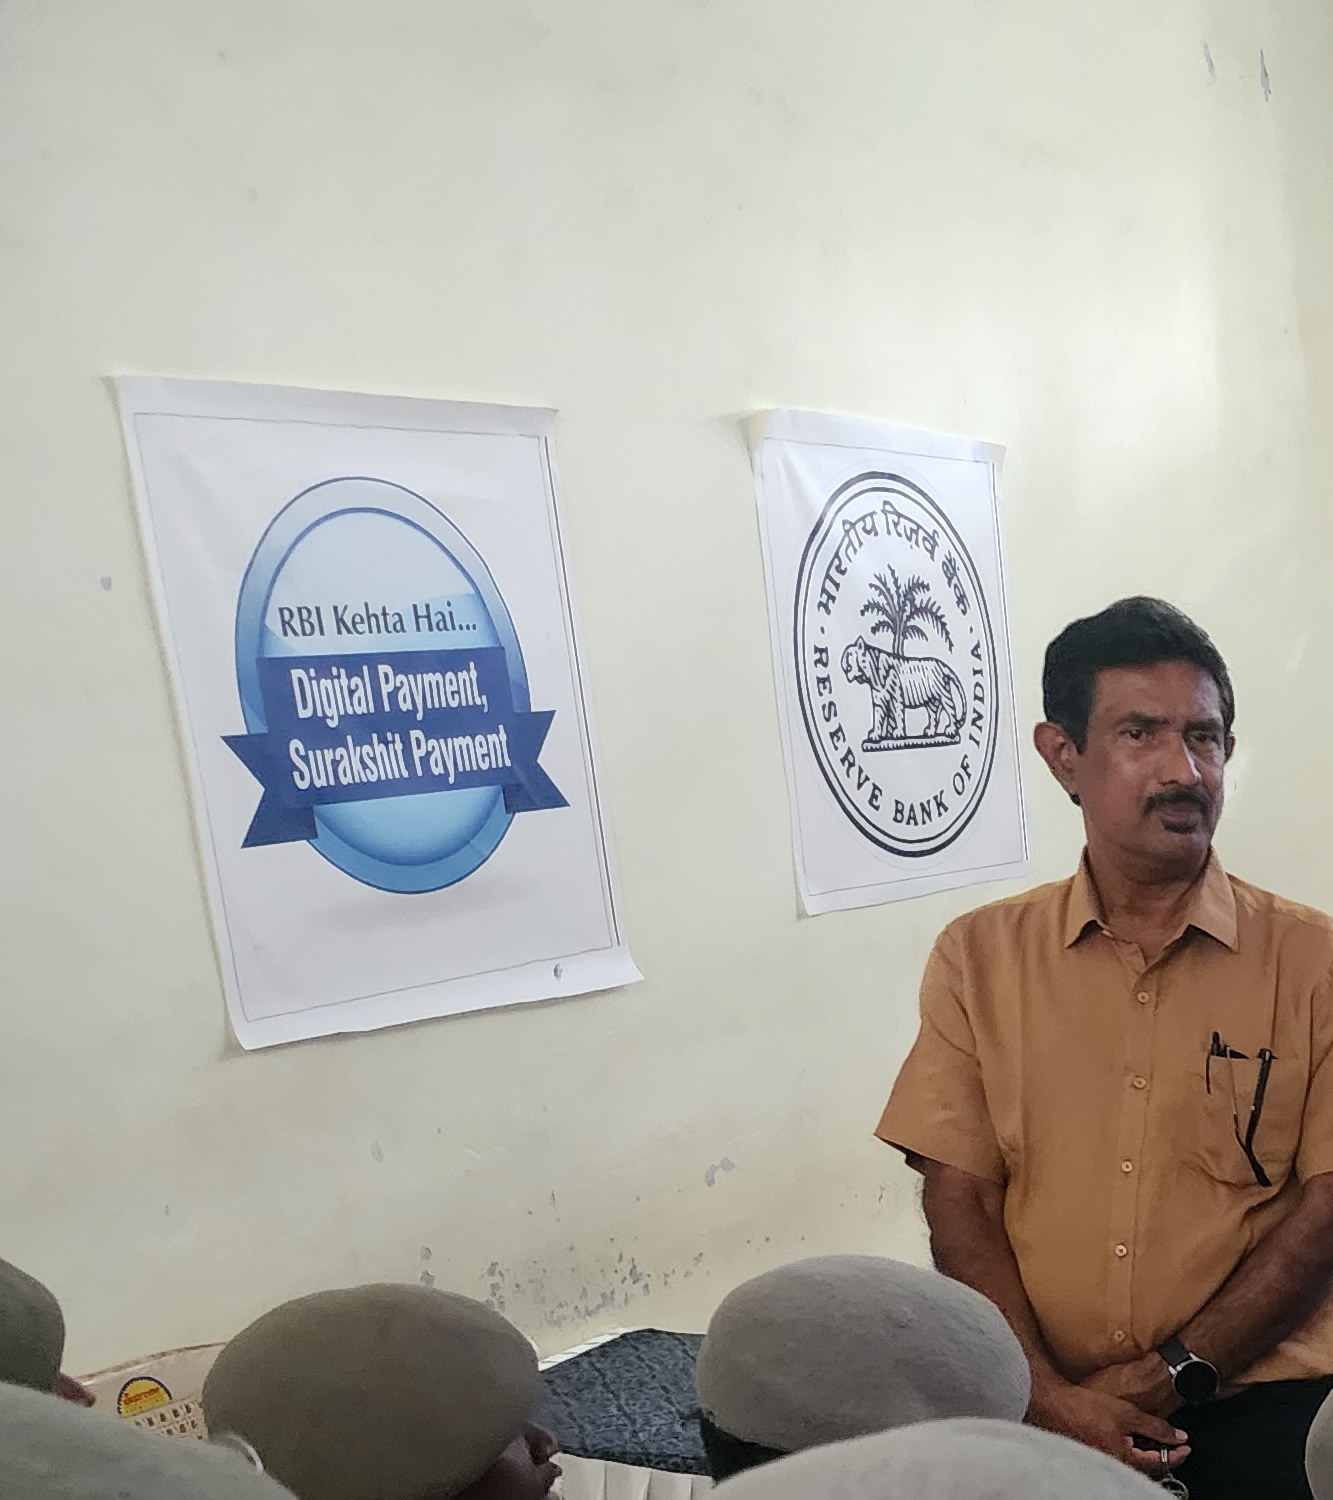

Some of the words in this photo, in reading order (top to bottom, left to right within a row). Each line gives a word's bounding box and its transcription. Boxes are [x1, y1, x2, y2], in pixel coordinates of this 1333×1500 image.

[817, 510, 879, 615] भारतीय
[278, 605, 325, 638] RBI
[333, 603, 405, 636] Kehta
[412, 600, 477, 633] Hai...
[290, 666, 374, 728] Digital
[377, 661, 489, 721] Payment,
[288, 733, 408, 790] Surakshit
[411, 724, 512, 784] Payment
[813, 644, 883, 811] RESERVE
[892, 789, 949, 827] BANK
[952, 753, 972, 796] OF
[968, 639, 986, 749] INDIA
